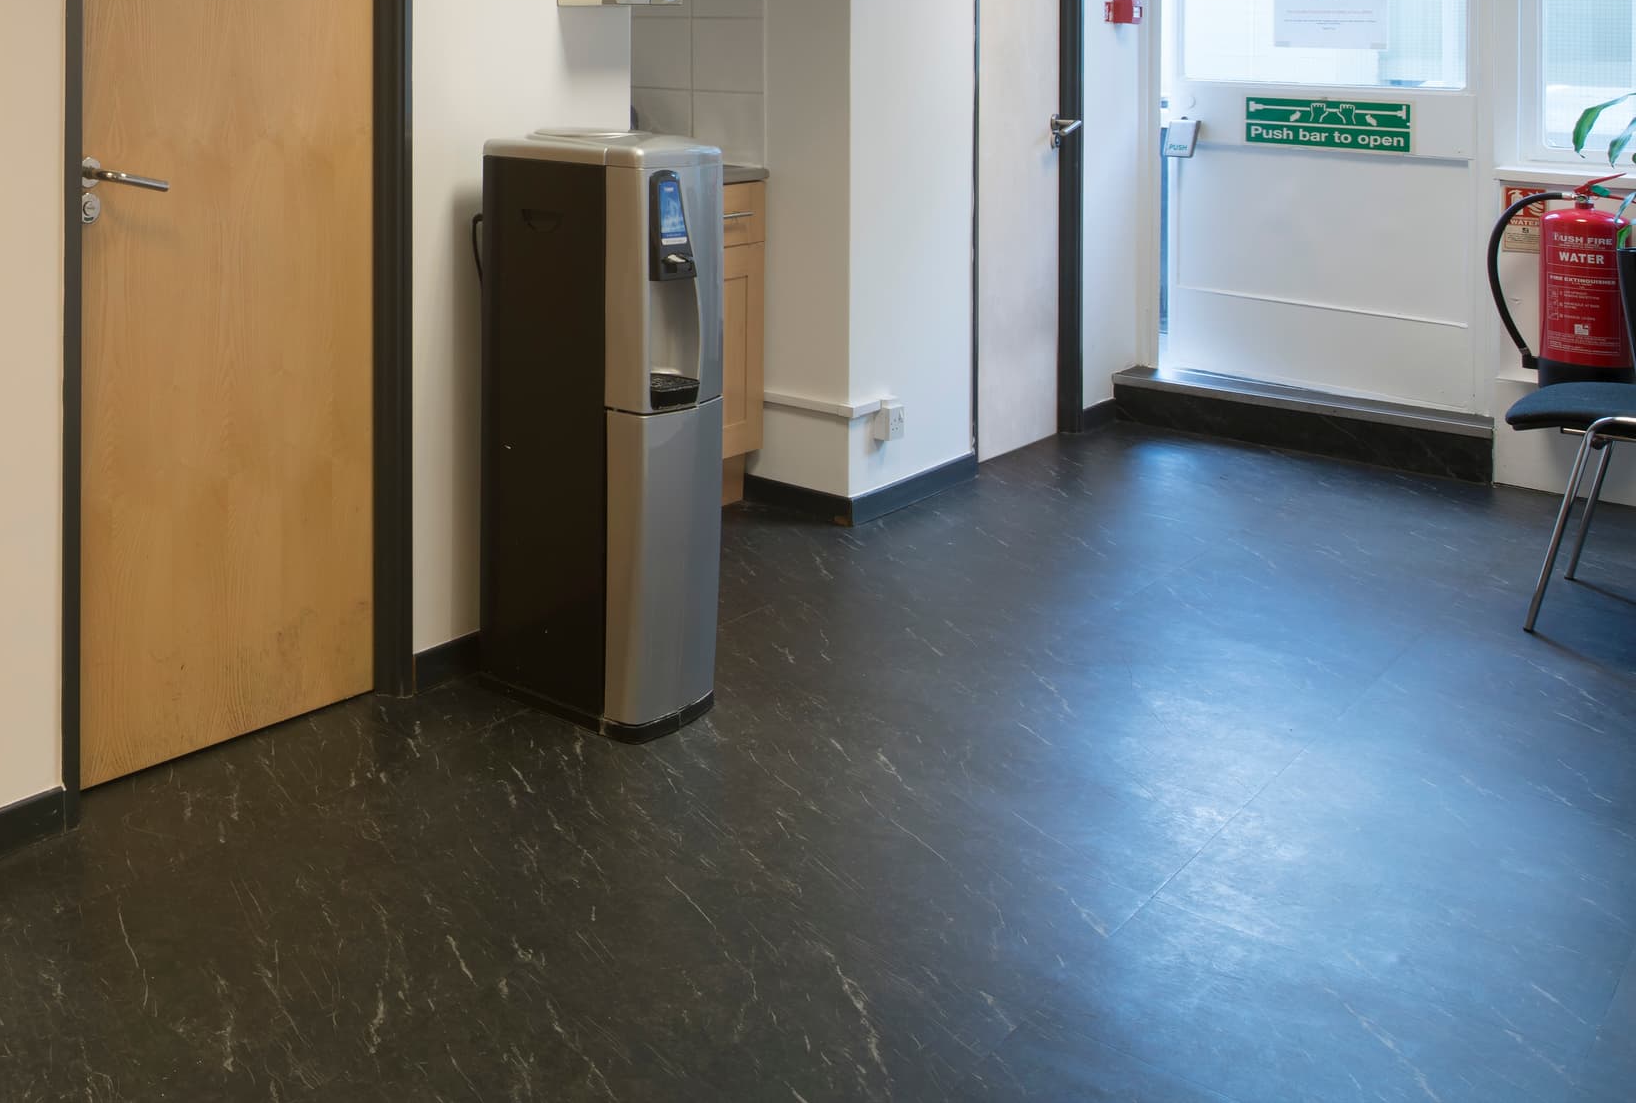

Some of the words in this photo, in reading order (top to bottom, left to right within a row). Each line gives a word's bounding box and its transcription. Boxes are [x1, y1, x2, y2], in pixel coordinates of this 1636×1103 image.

[1250, 125, 1293, 140] Push
[1298, 128, 1328, 142] bar
[1333, 131, 1352, 144] to
[1357, 134, 1405, 148] open
[1587, 237, 1613, 246] FIRE
[1559, 251, 1605, 264] WATER
